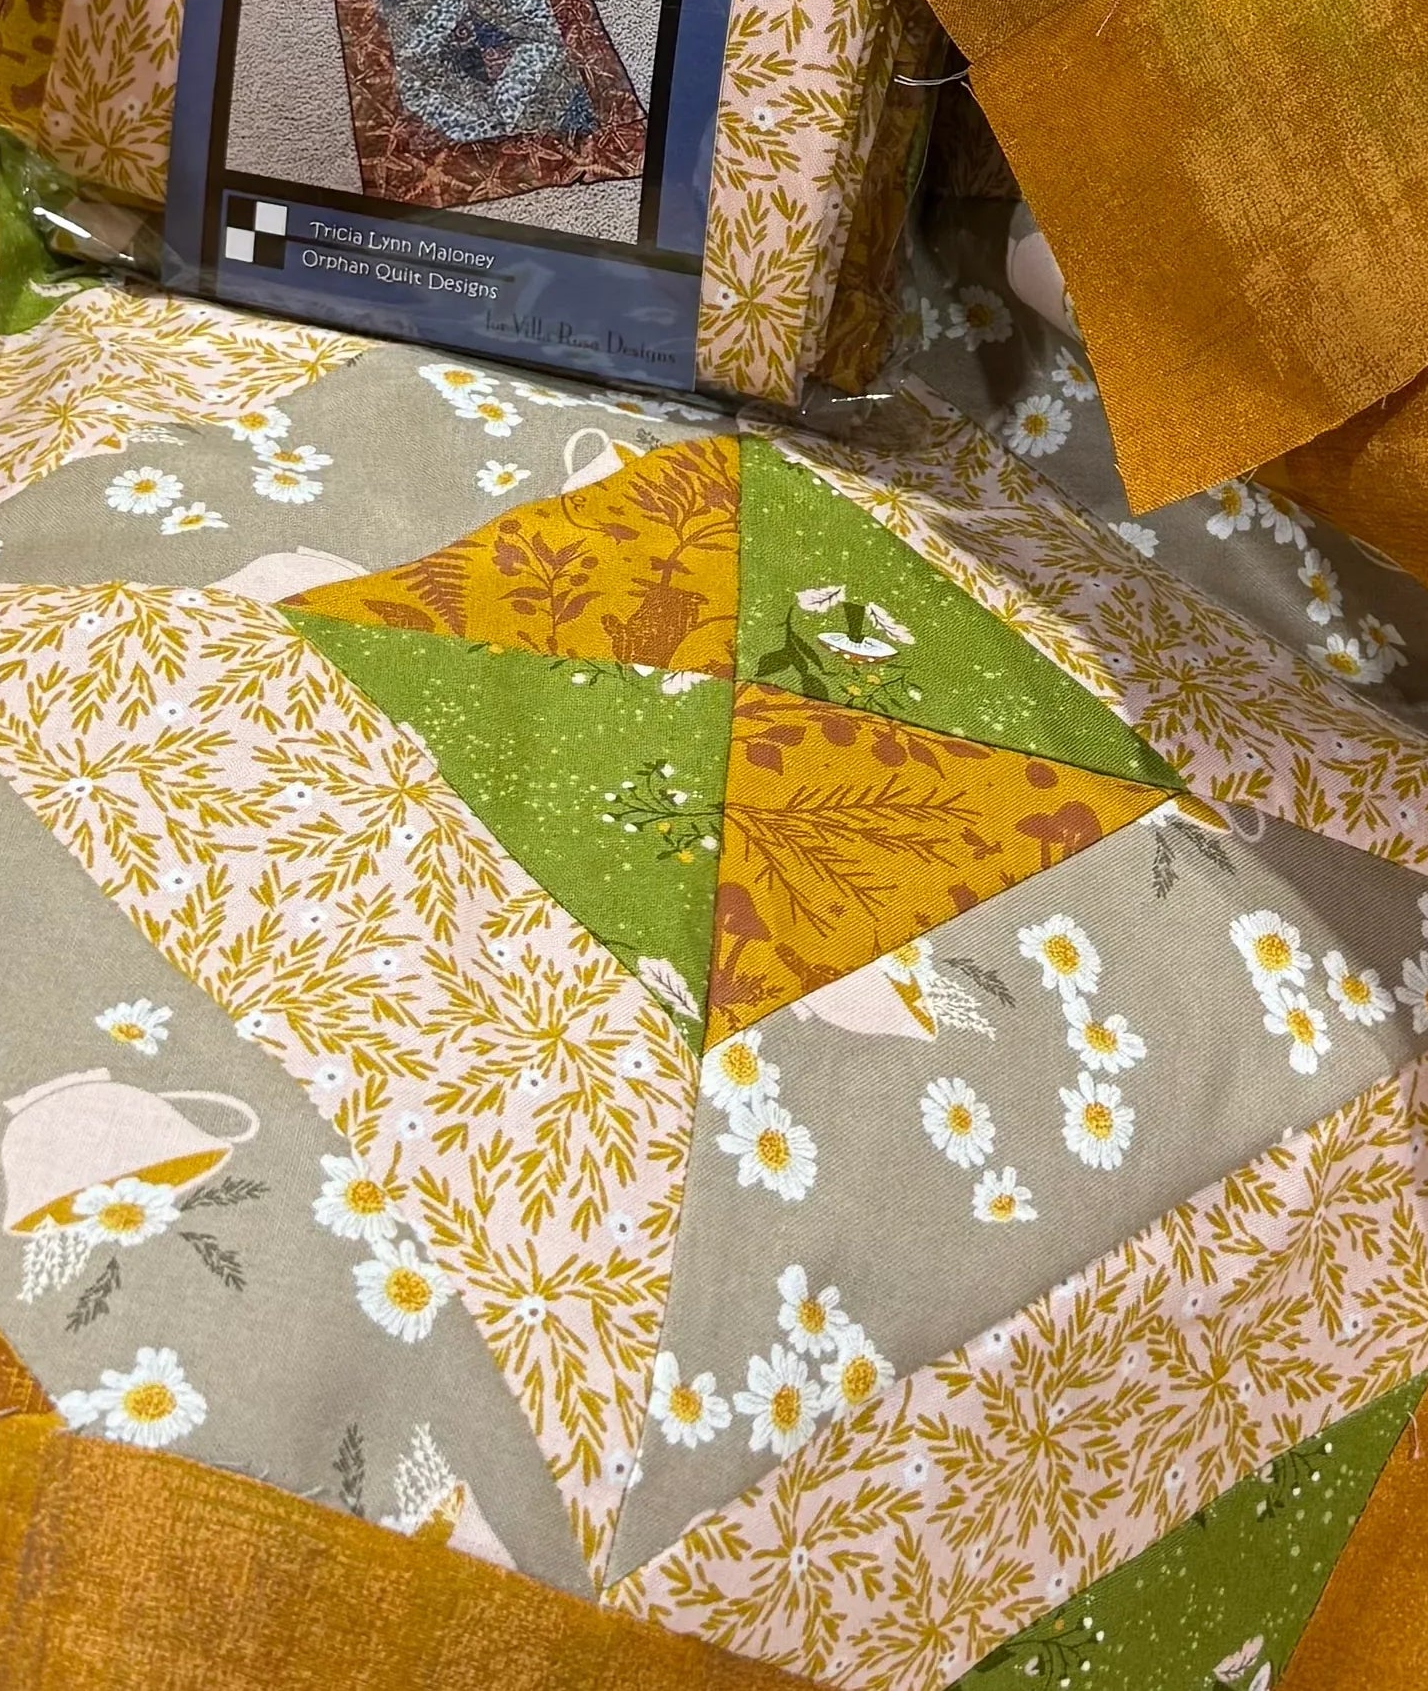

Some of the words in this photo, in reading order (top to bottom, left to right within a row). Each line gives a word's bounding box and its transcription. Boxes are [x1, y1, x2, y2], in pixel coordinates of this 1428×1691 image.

[309, 221, 363, 245] Tricia
[368, 231, 412, 254] Lynn
[418, 240, 495, 269] Maloney
[302, 249, 370, 276] Orphan
[375, 263, 422, 285] Quilt
[428, 272, 498, 300] Designs
[607, 330, 677, 364] Designs
